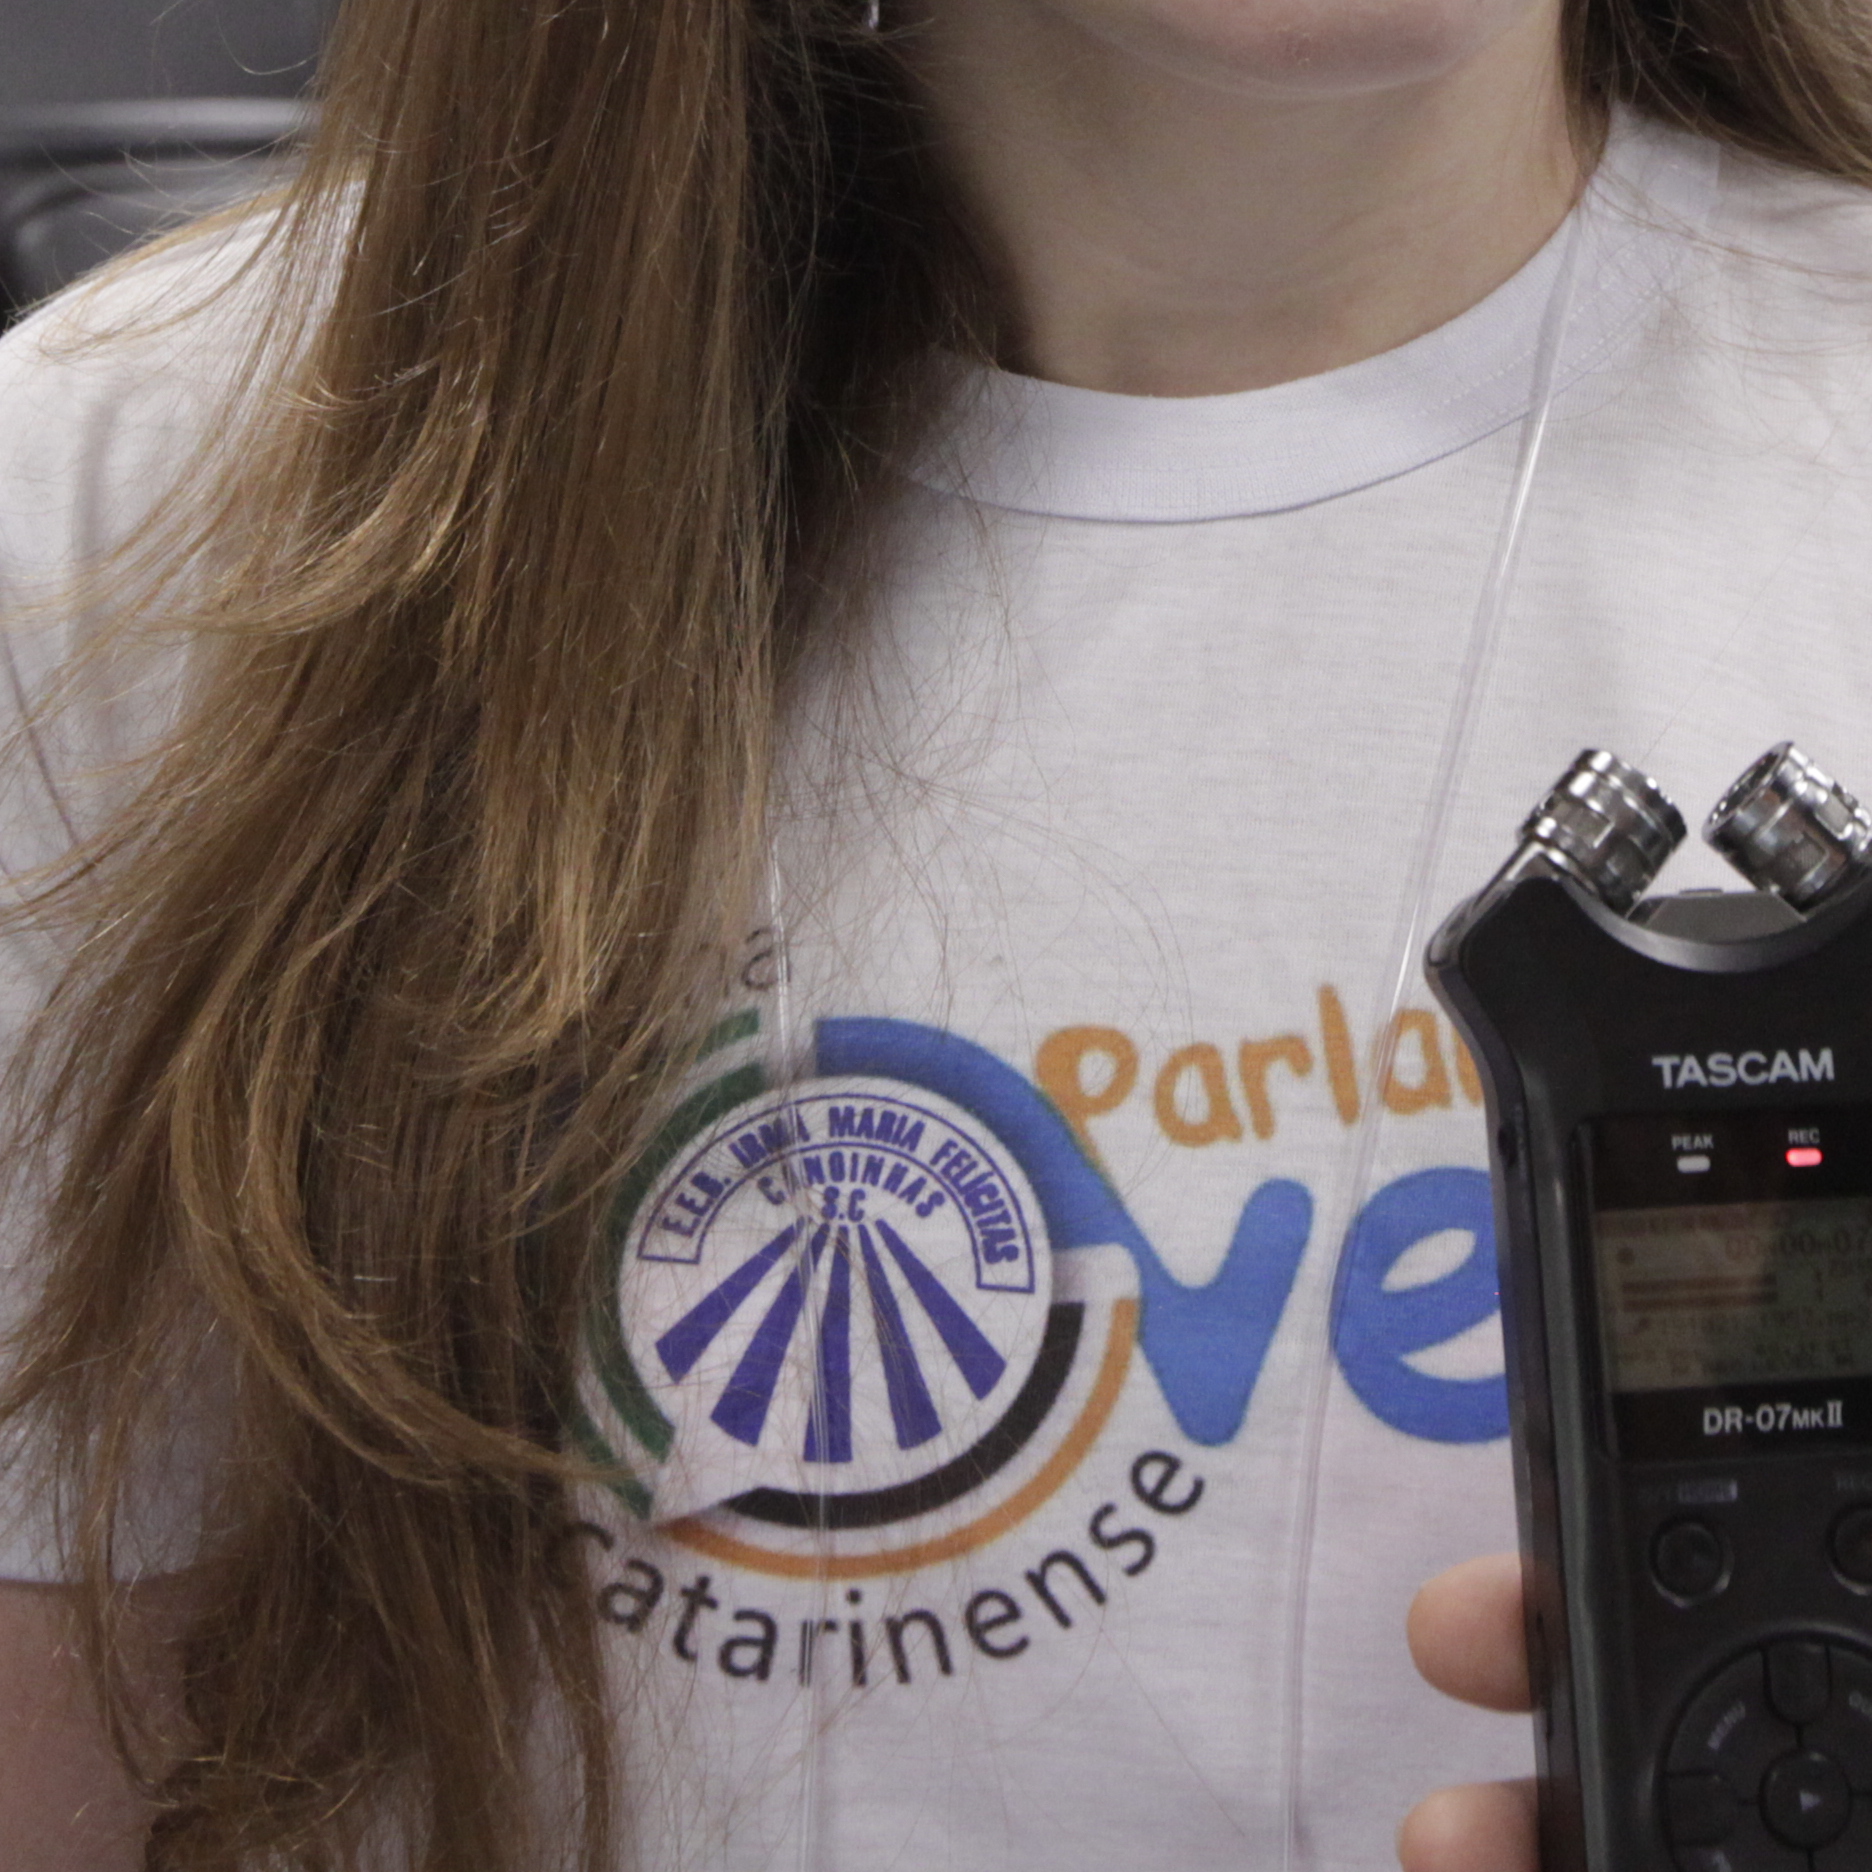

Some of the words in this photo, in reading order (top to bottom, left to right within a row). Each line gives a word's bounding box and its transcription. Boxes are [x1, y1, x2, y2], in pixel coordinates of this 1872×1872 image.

[1651, 1046, 1836, 1090] TASCAM
[828, 1105, 925, 1153] MARIA
[1671, 1134, 1715, 1151] PEAK
[1787, 1129, 1821, 1145] REC
